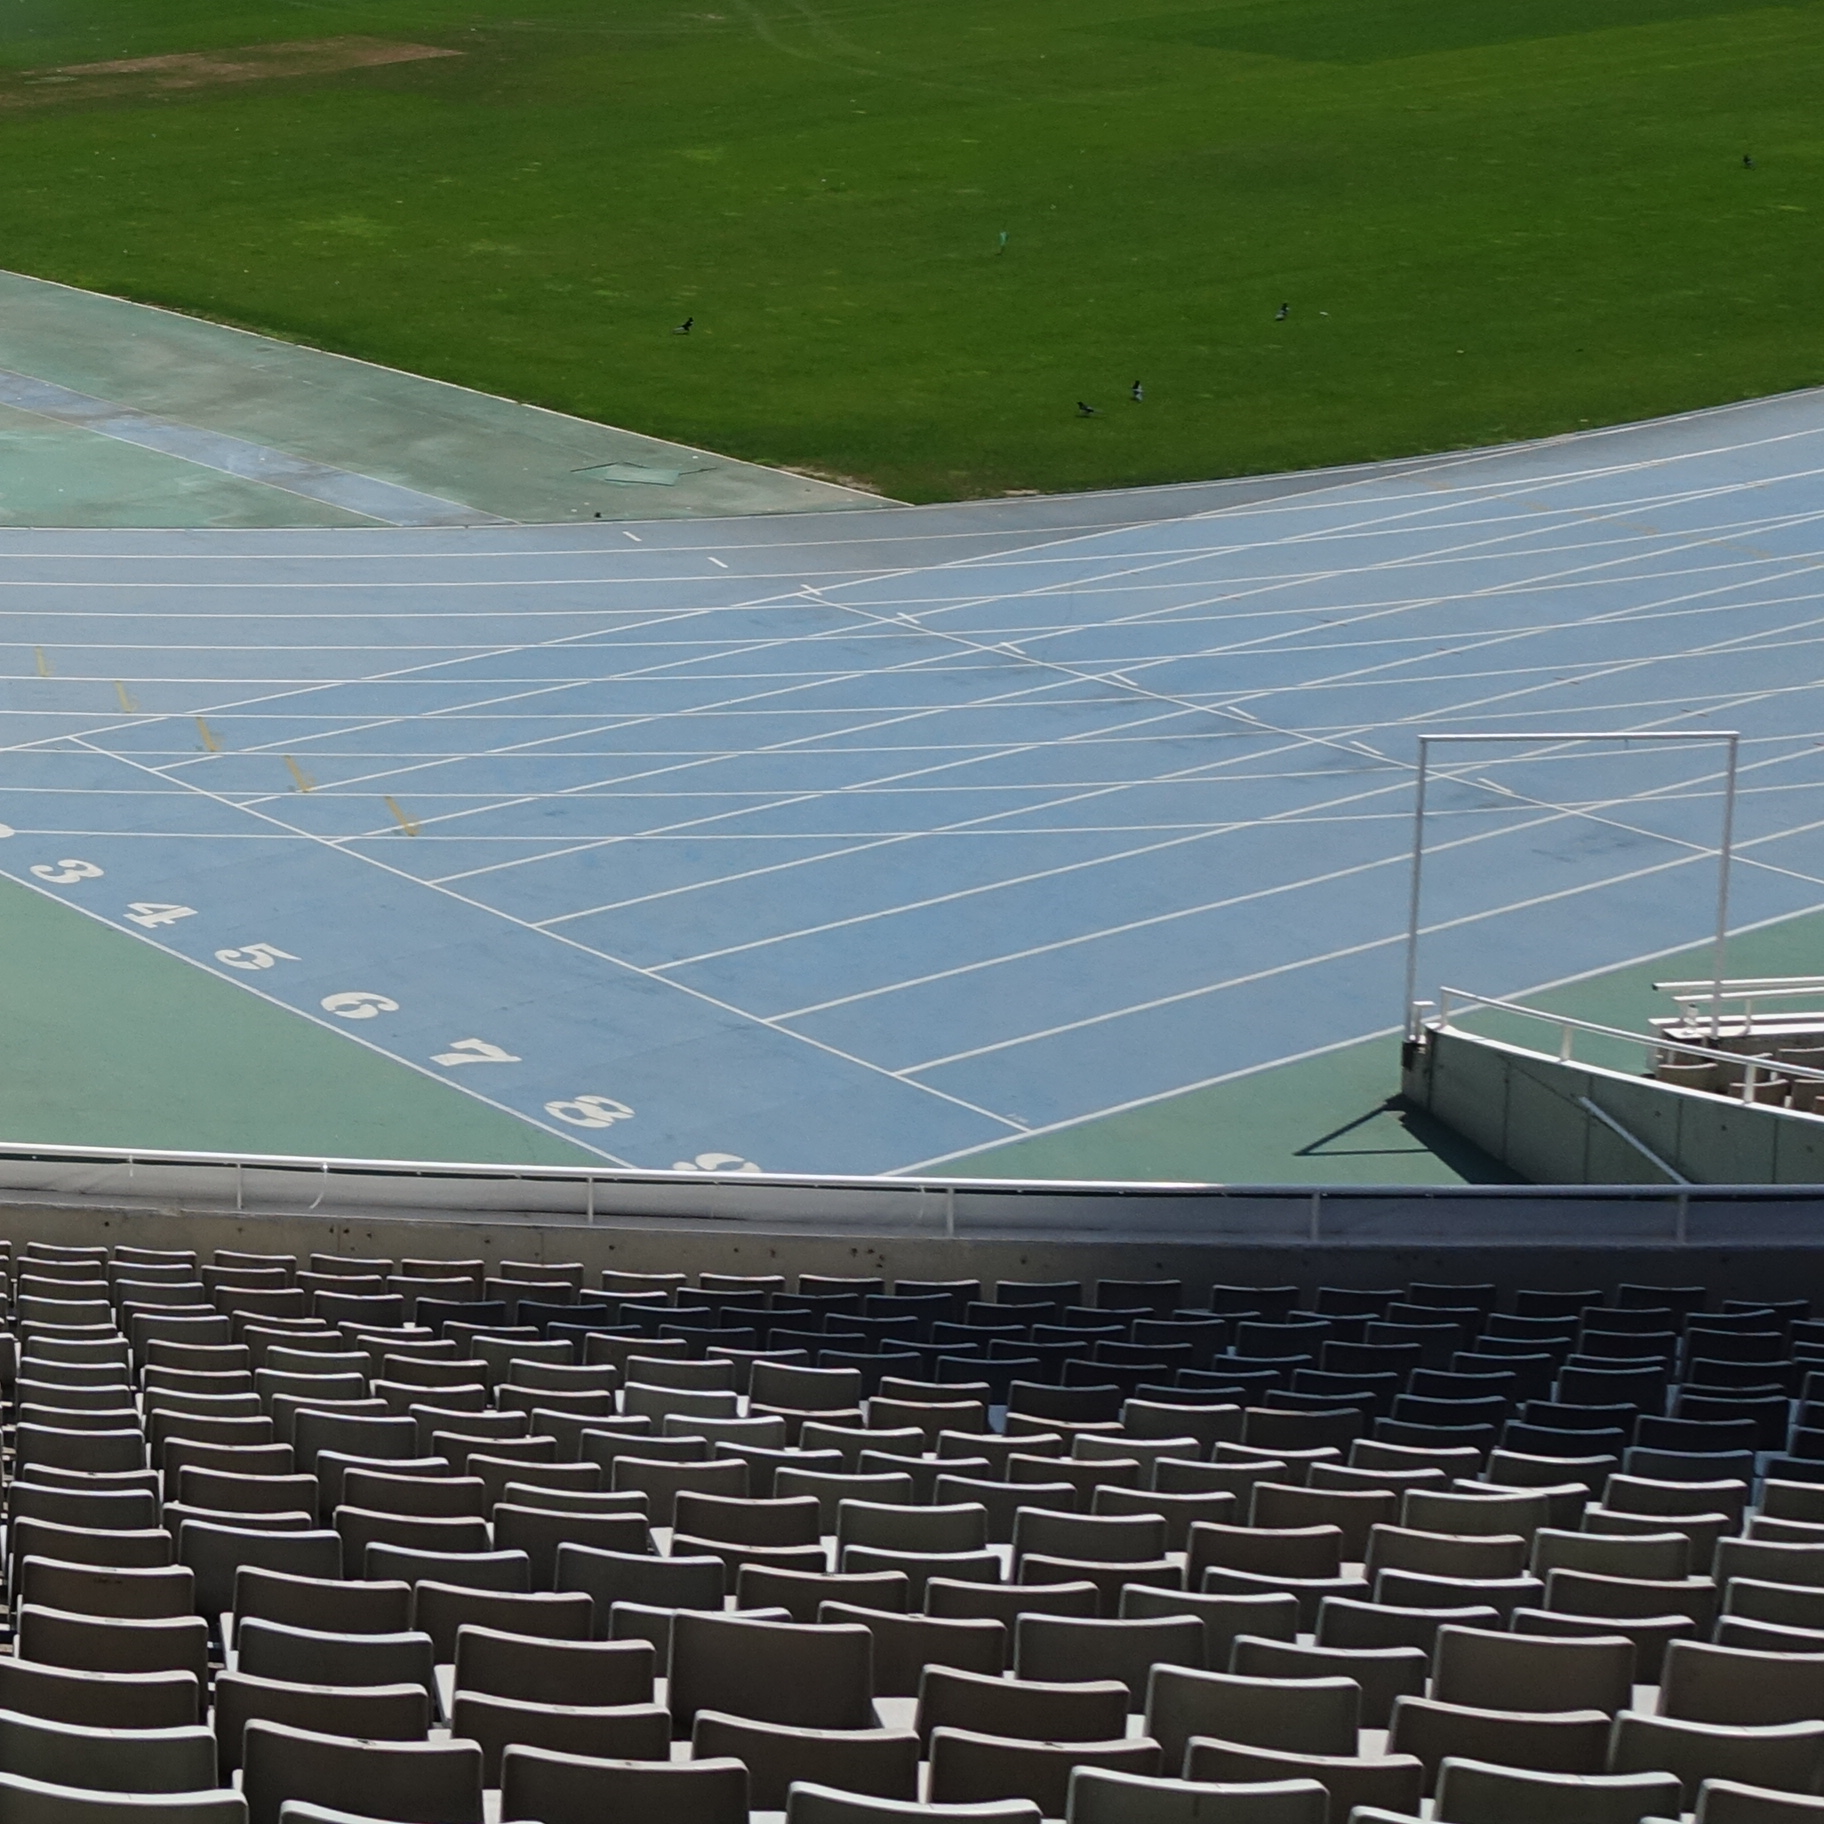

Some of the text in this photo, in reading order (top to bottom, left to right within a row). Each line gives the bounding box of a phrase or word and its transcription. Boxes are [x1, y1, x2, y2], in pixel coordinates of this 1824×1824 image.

[30, 859, 104, 884] 3
[123, 902, 198, 928] 4
[214, 943, 302, 970] 5
[320, 991, 399, 1019] 6
[429, 1038, 522, 1066] 7
[544, 1095, 635, 1128] 8
